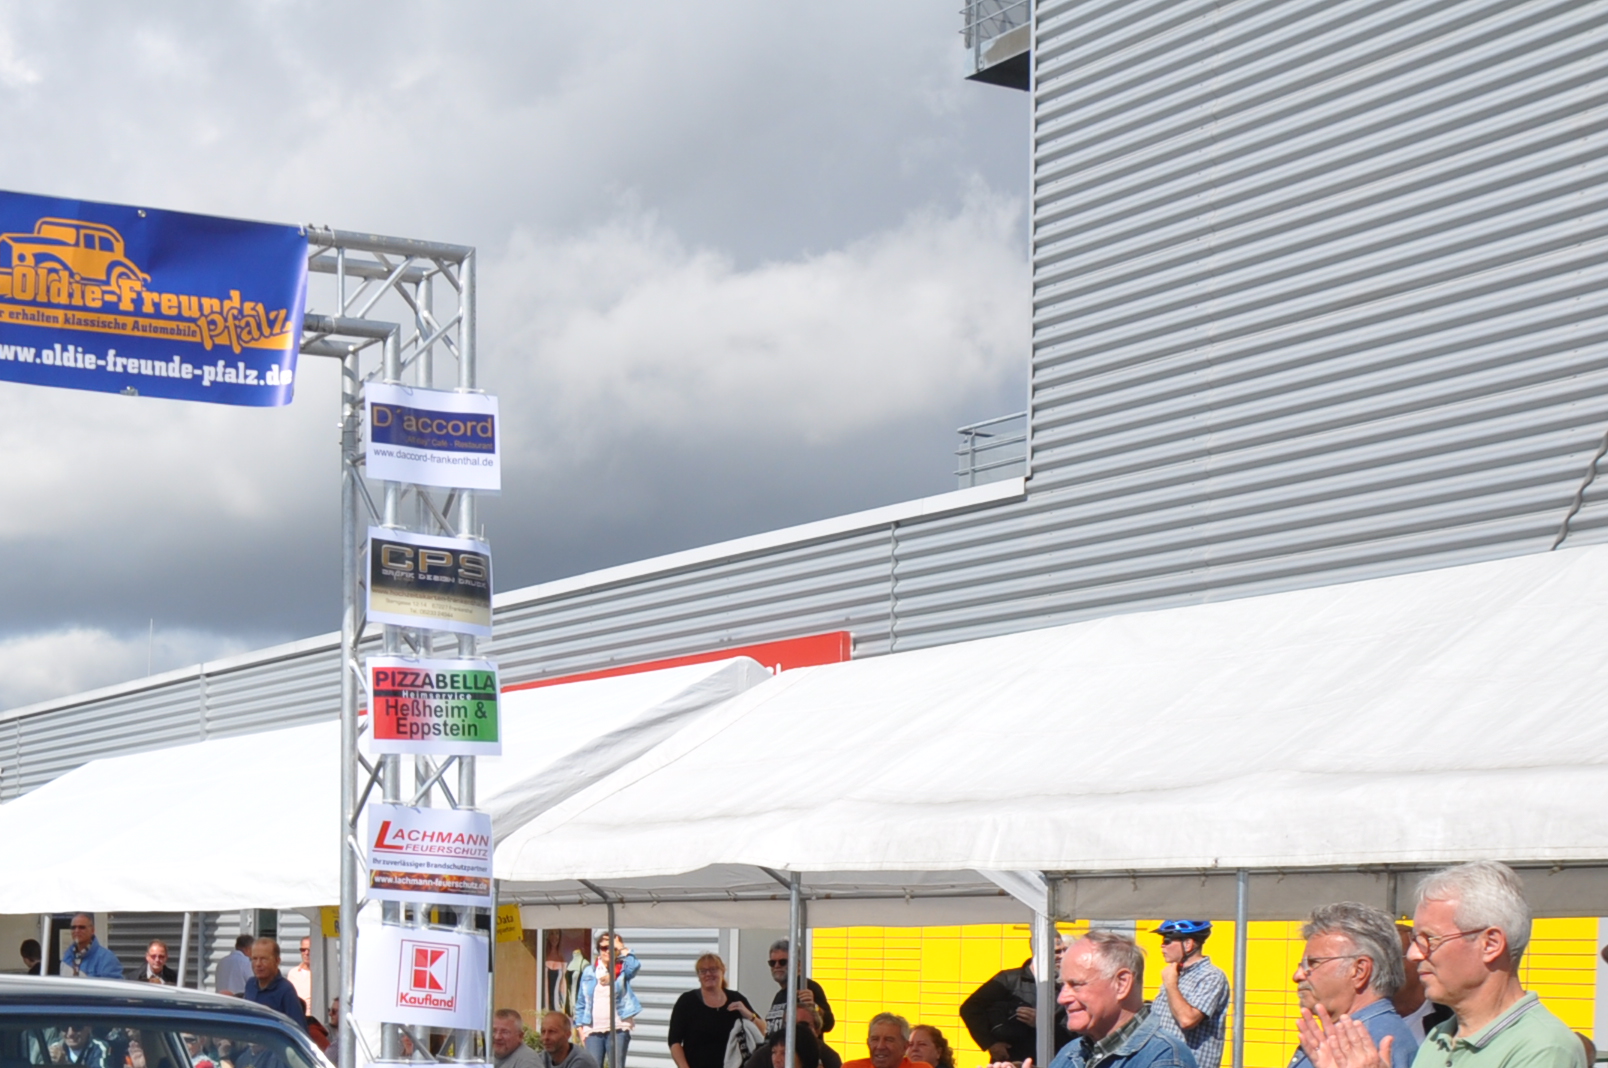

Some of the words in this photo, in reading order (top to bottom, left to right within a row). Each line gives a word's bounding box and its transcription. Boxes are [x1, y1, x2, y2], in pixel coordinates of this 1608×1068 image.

[8, 306, 60, 325] erhalten
[64, 313, 128, 331] klassische
[132, 317, 197, 338] Automobile
[374, 448, 494, 467] www.daccord-frankenthal.de
[381, 544, 487, 581] CPS
[375, 671, 496, 692] PIZZABELLA
[402, 689, 472, 701] Heimservice
[385, 698, 468, 719] Heßheim
[474, 701, 487, 719] &
[396, 716, 478, 740] Eppstein
[374, 820, 490, 850] LACHMANN
[405, 843, 488, 858] FEUERSCHUTZ
[374, 875, 488, 890] www.lachmann-feuerschutz.de
[400, 991, 454, 1008] Kaufland
